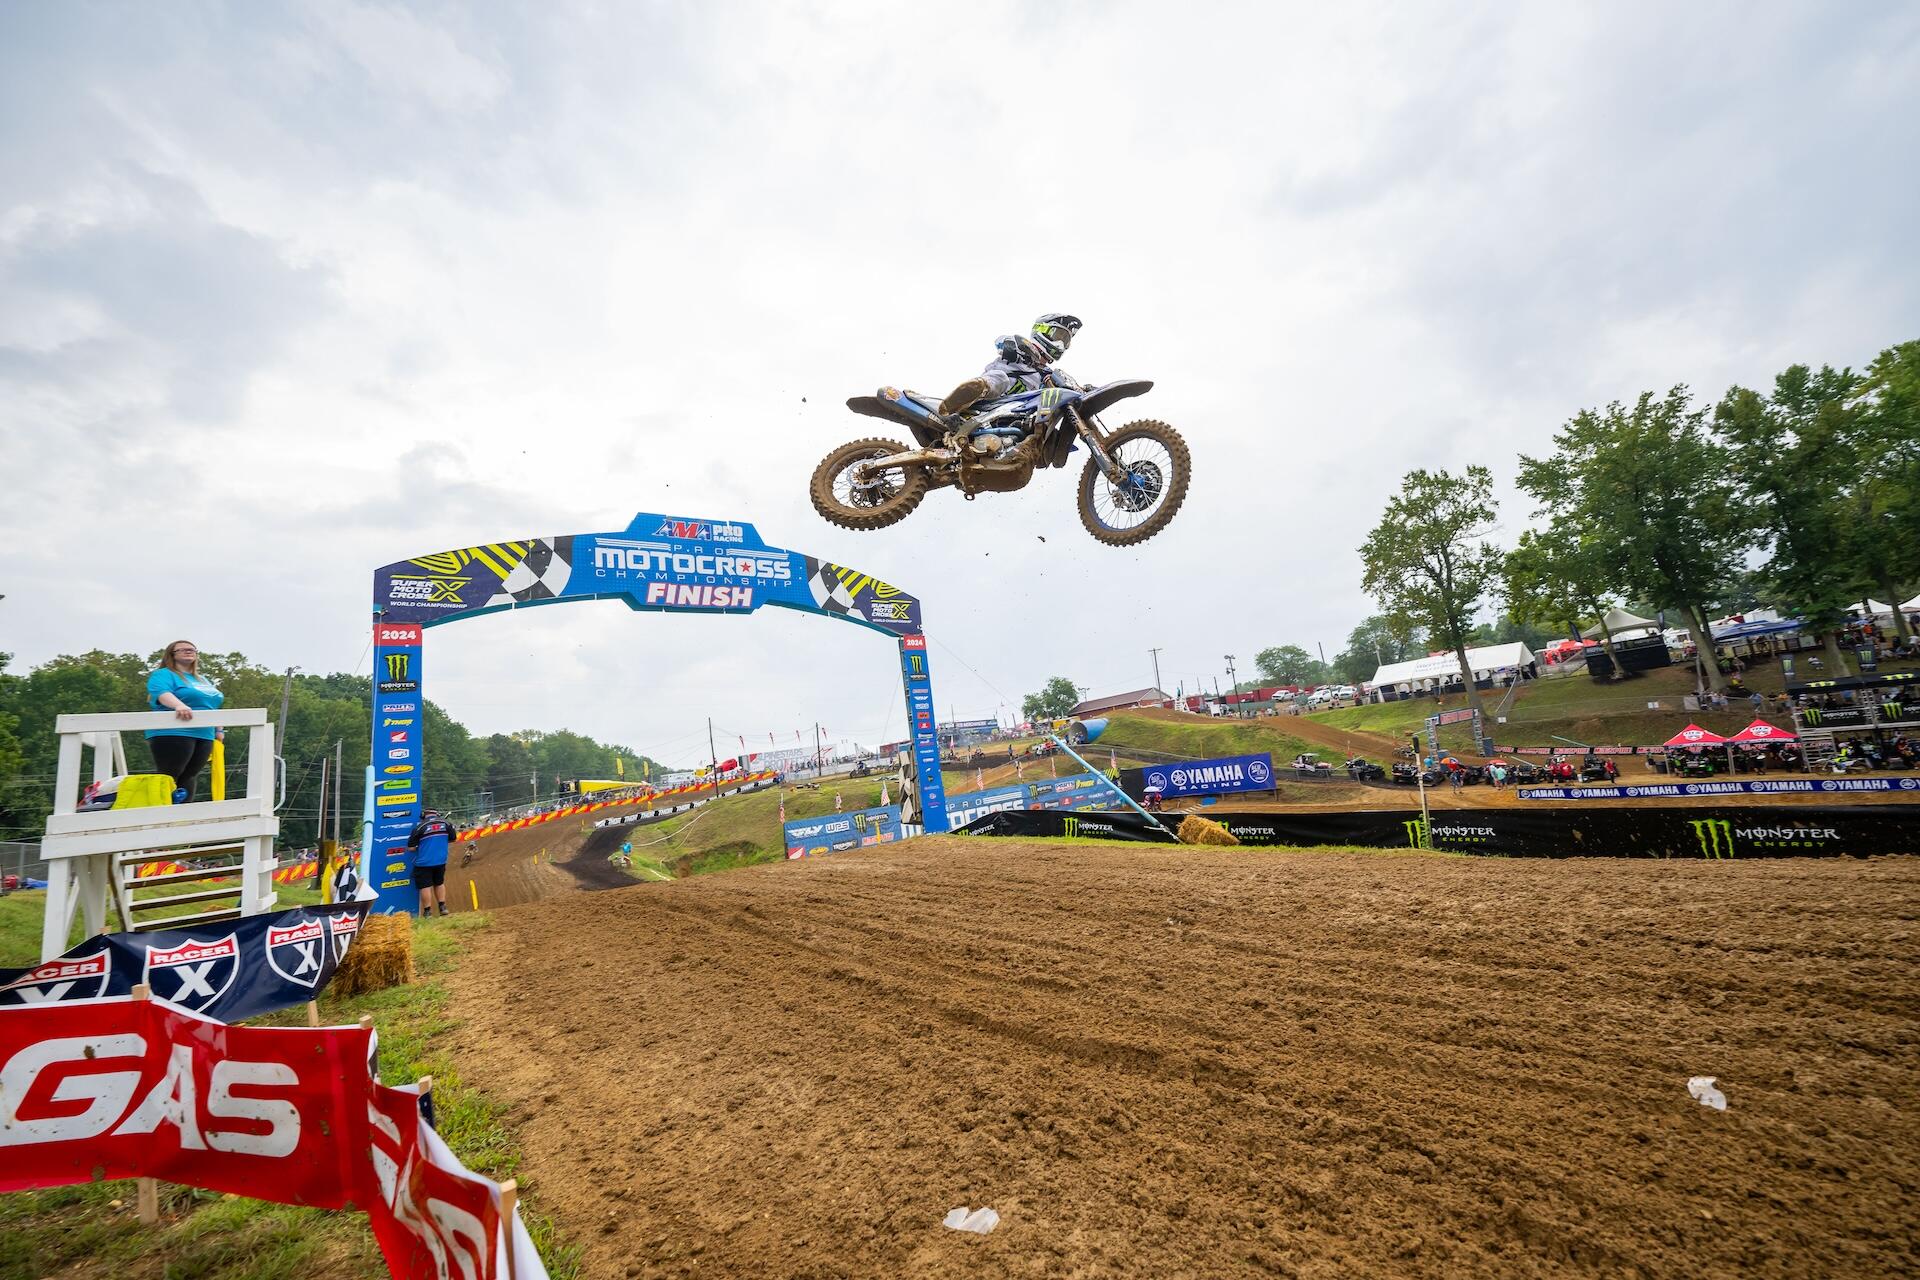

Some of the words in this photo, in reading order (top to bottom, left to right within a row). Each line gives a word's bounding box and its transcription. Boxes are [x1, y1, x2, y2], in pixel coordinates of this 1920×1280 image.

[652, 519, 711, 541] AMA
[712, 525, 743, 536] PRO
[595, 547, 791, 579] MOTOCROSS
[595, 569, 792, 588] CHAMPIONSHIP
[390, 580, 433, 588] SUPER
[392, 586, 432, 594] MOTO
[647, 582, 752, 606] FINISH
[389, 592, 432, 600] CROSS
[382, 630, 416, 640] 2024
[1186, 764, 1244, 783] YAMAHA
[1179, 781, 1241, 790] RACING
[1698, 782, 1743, 793] YAMAHA
[1764, 780, 1813, 790] YAMAHA
[1836, 779, 1890, 790] YAMAHA
[1530, 790, 1566, 798] YAMAHA
[1581, 788, 1620, 797] YAMAHA
[1638, 786, 1680, 795] YAMAHA
[1078, 823, 1114, 831] MONSTER
[1231, 826, 1275, 835] MONSTER
[1432, 826, 1496, 836] MONSTER
[1736, 827, 1840, 840] MONSTER
[154, 945, 230, 964] RACER
[293, 940, 320, 977] X
[168, 960, 216, 1002] X
[0, 1033, 301, 1158] GAS
